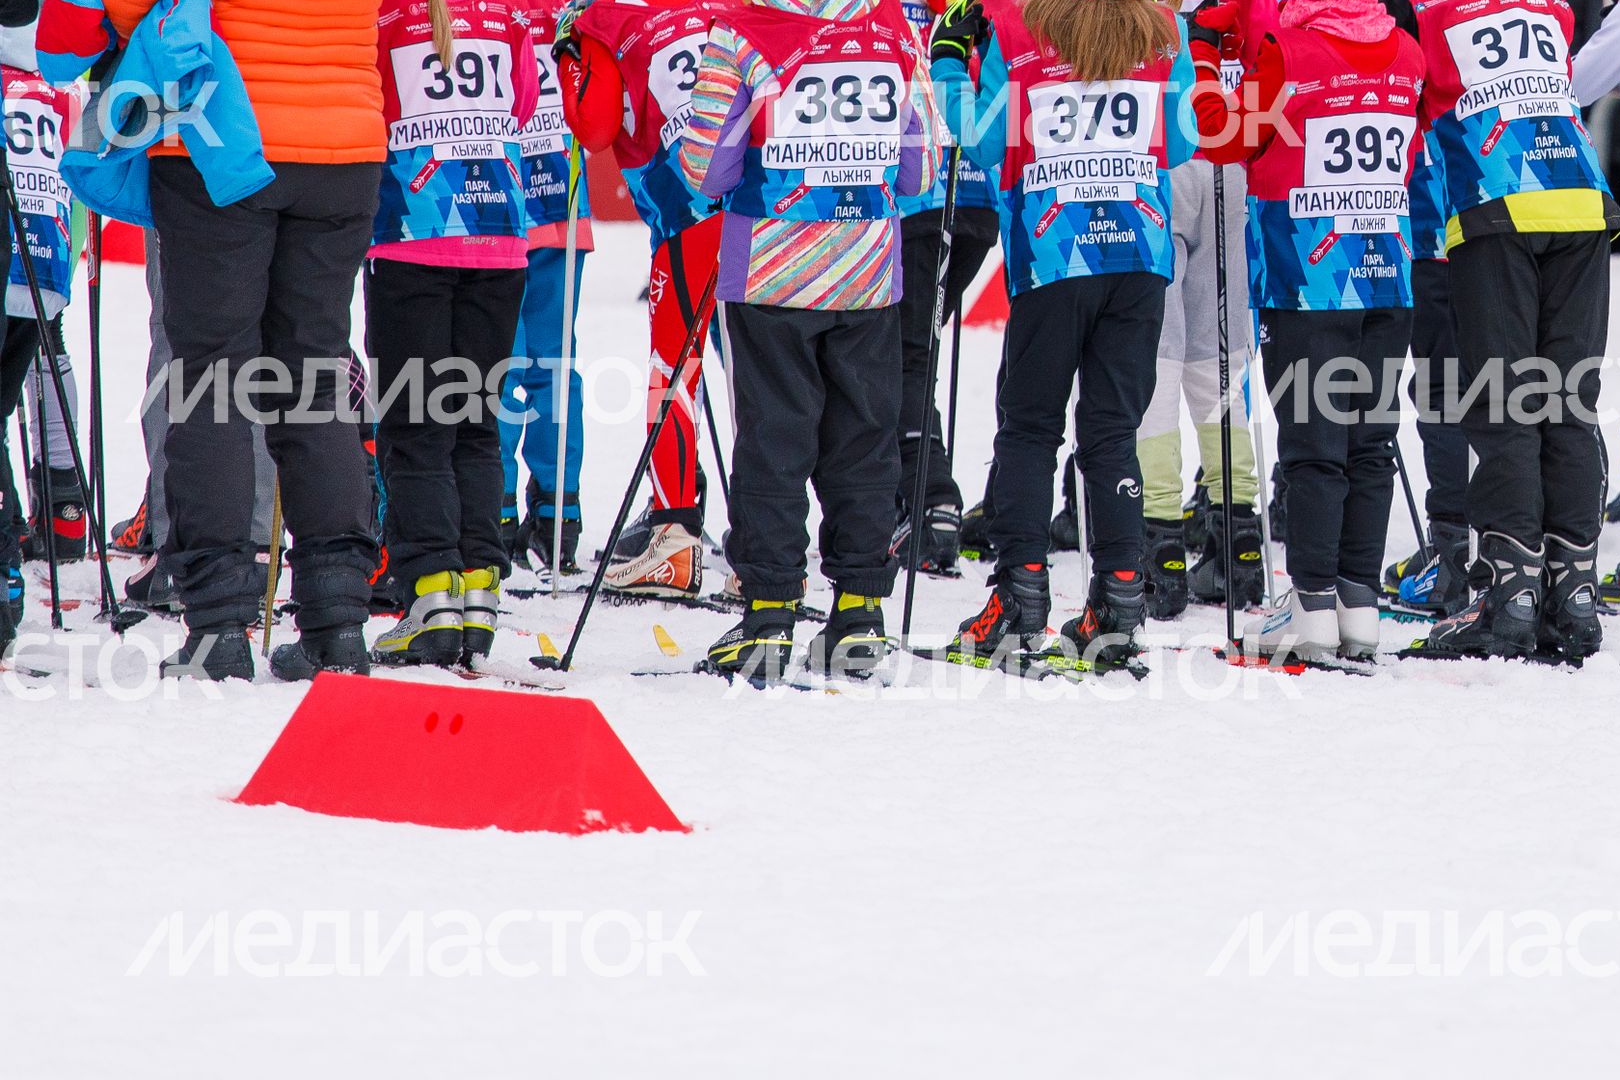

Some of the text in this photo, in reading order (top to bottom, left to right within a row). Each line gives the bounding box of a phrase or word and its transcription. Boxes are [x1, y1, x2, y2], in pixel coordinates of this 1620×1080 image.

[1471, 18, 1559, 69] 376
[421, 51, 504, 100] 391
[794, 74, 898, 124] 383
[1517, 101, 1560, 116] ЛЫЖНЯ
[1048, 91, 1140, 144] 379
[1323, 125, 1405, 174] 393
[1534, 134, 1562, 149] ПАРК
[451, 142, 494, 158] ЛЫЖНЯ
[1522, 143, 1578, 162] ЛАЗУТИНОЙ
[530, 172, 554, 188] ПАРК
[822, 168, 872, 184] ЛЫЖНЯ
[464, 180, 490, 193] ПАРК
[1074, 185, 1120, 200] ЛЫЖНЯ
[452, 189, 508, 205] ЛАЗУТИНОЙ
[834, 205, 863, 218] ПАРК
[1089, 219, 1118, 232] ПАРК
[1352, 217, 1387, 232] ЛЫЖНЯ
[1074, 227, 1137, 246] ЛАЗУТИНОЙ
[1363, 254, 1385, 267] ПАРК
[1348, 263, 1398, 279] ЛАЗУТИНОЙ
[934, 286, 946, 332] SPORT
[946, 652, 993, 669] FISCHER
[1046, 655, 1092, 673] FISCHER
